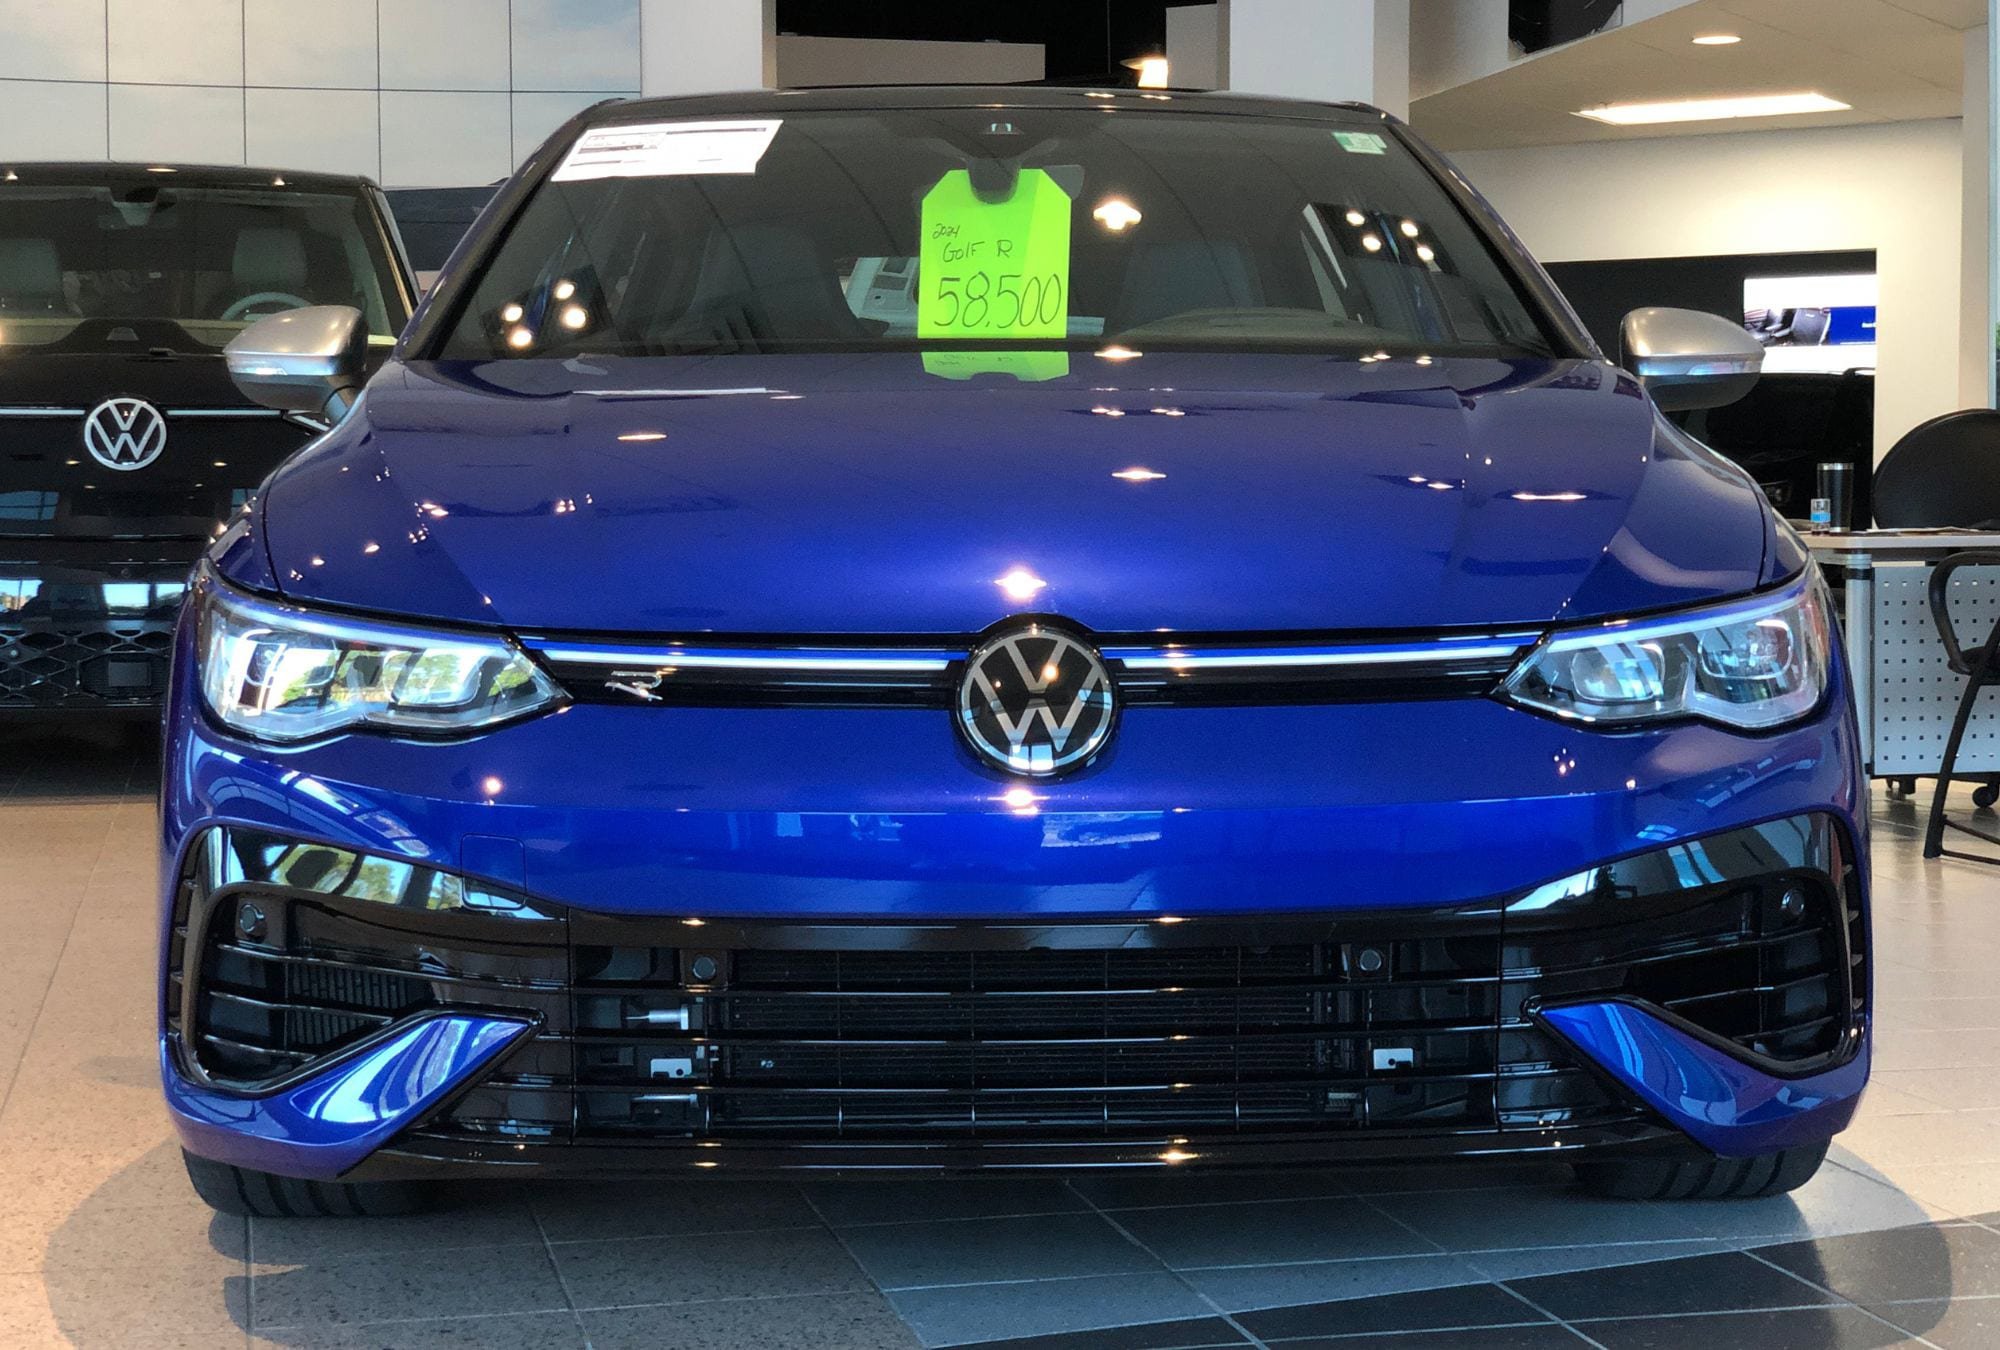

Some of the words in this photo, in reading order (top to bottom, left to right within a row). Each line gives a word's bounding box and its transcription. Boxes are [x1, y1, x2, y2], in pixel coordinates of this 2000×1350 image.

[996, 239, 1013, 258] R
[87, 399, 163, 464] VW
[967, 634, 1106, 760] VW
